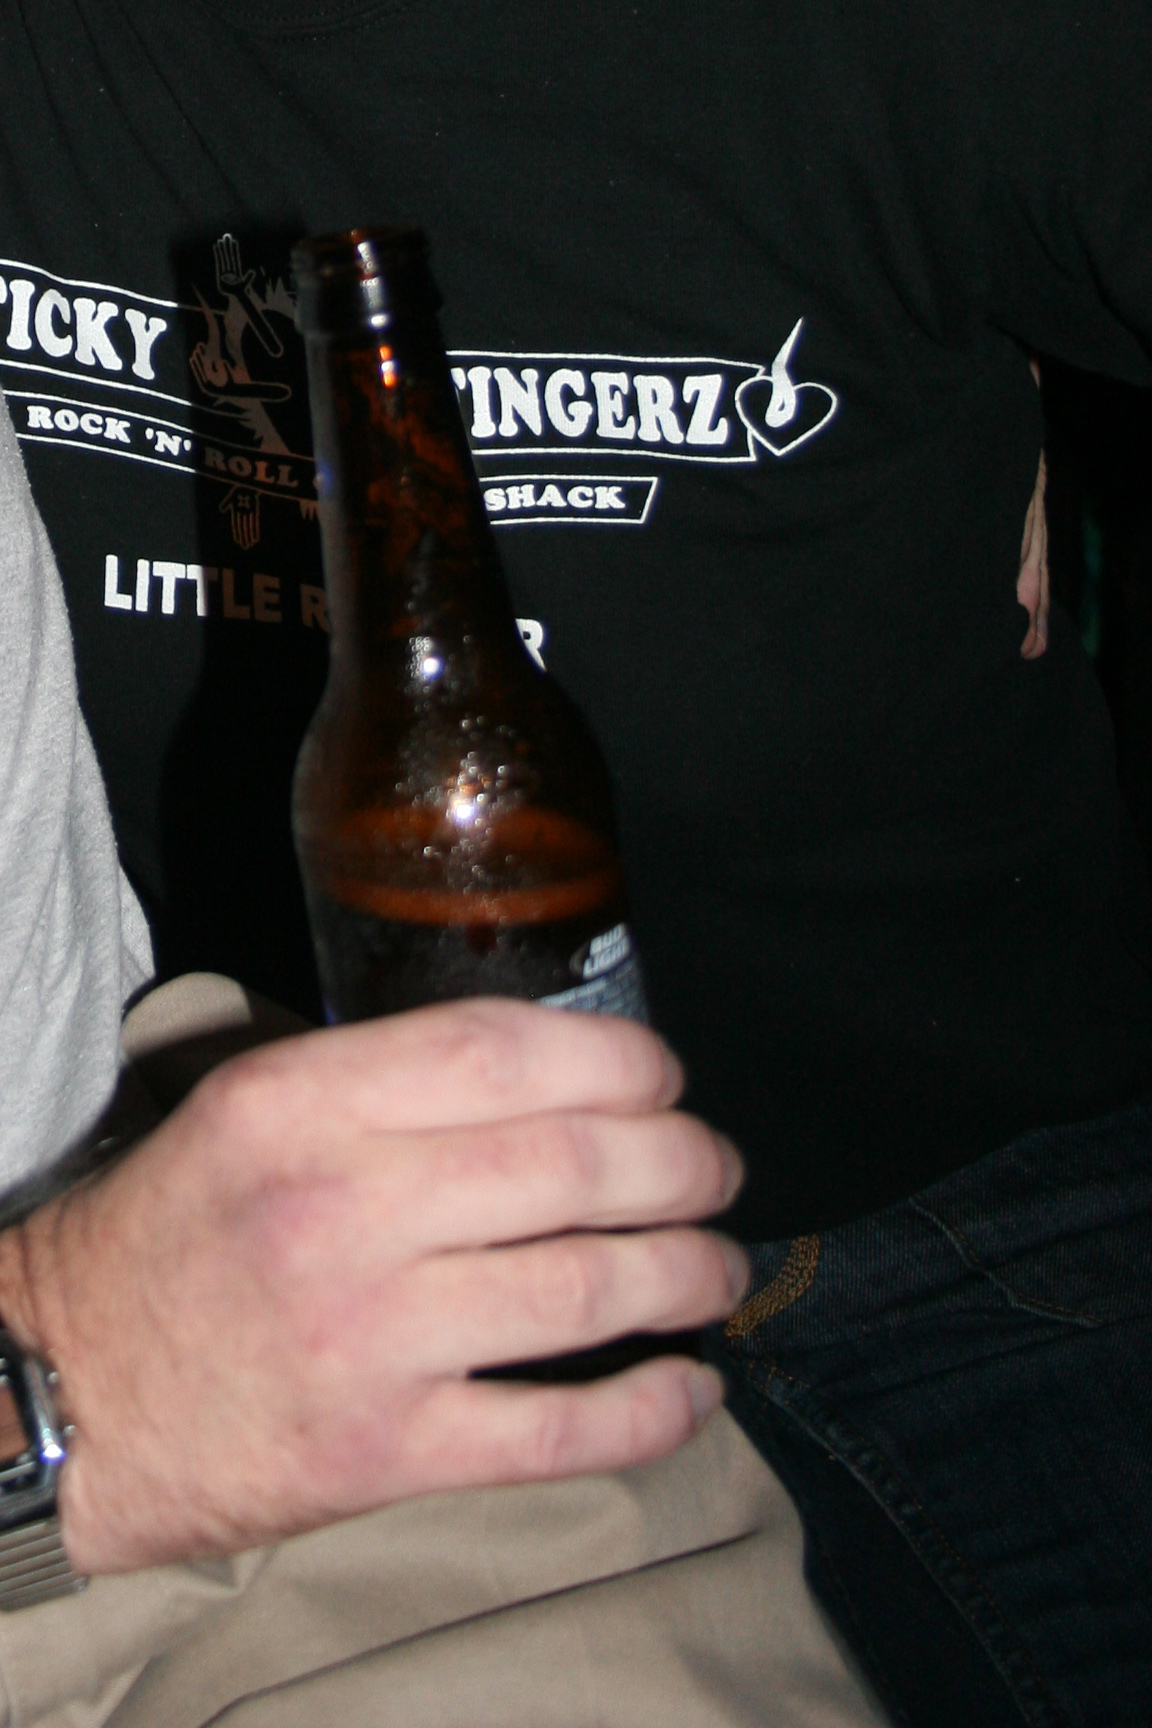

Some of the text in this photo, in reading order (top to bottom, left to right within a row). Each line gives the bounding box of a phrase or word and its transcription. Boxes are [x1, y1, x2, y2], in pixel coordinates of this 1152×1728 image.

[450, 365, 728, 446] INGERZ
[26, 405, 626, 512] ROCK 'N' ROLL SHACK
[103, 553, 283, 623] LITTLE
